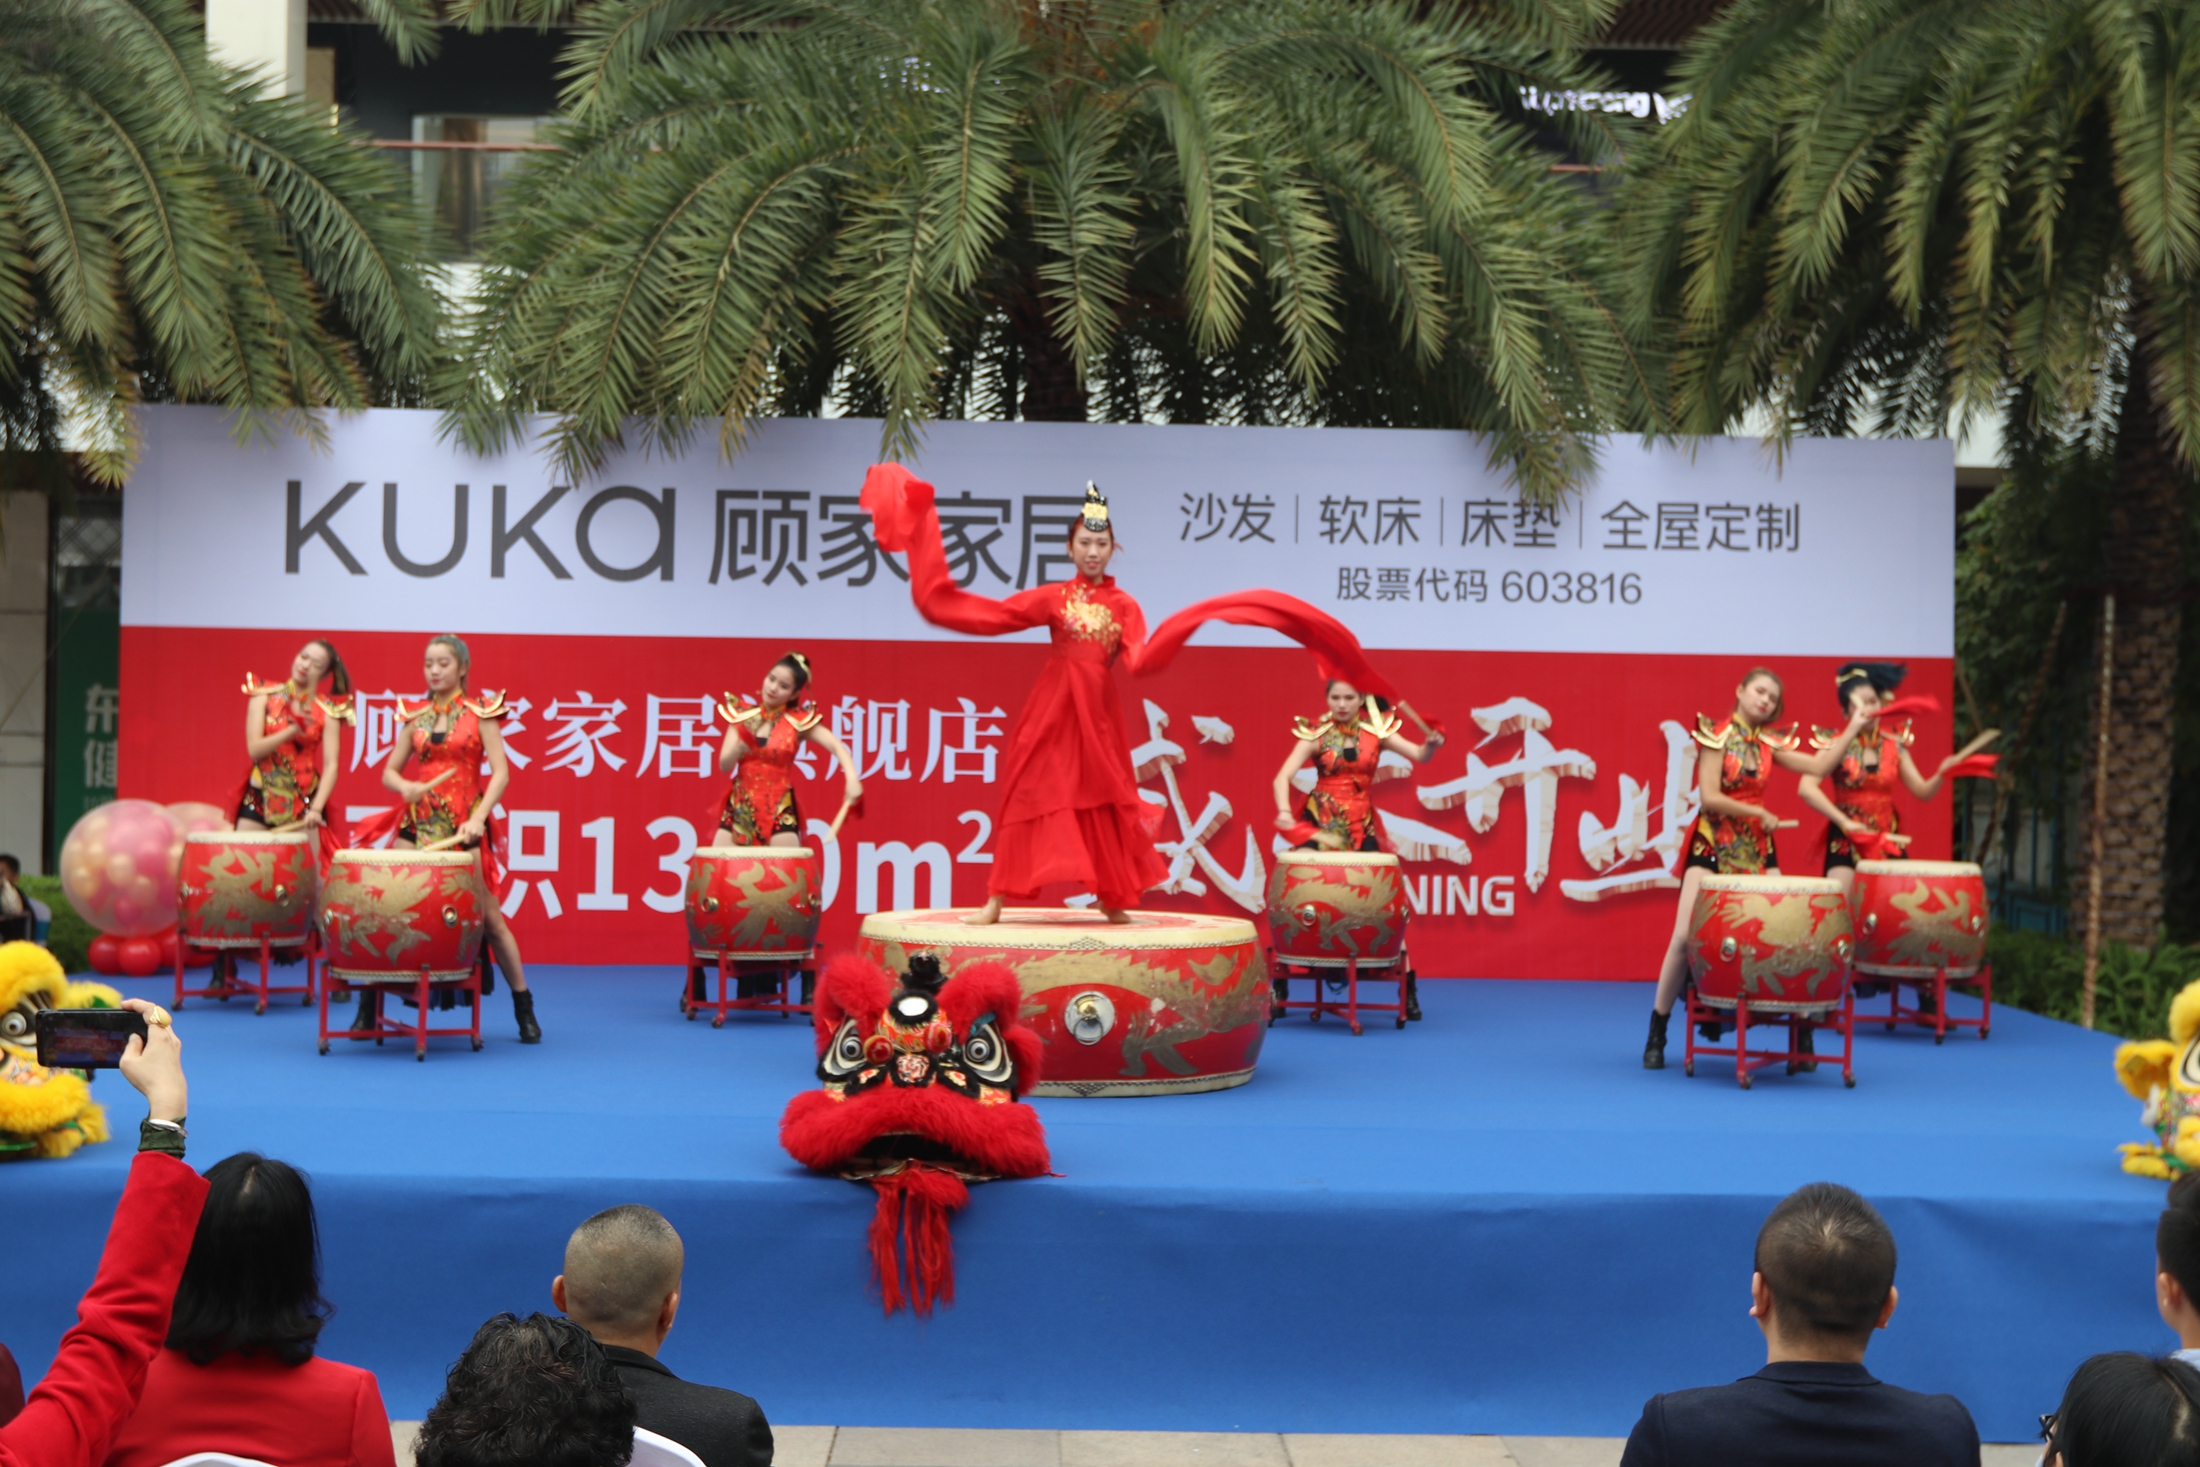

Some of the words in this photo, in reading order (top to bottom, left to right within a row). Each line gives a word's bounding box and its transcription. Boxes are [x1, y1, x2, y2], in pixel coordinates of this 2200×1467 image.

[1180, 492, 1276, 543] 沙发
[1319, 494, 1421, 546] 软床
[1461, 497, 1560, 548] 床垫
[1601, 500, 1799, 552] 全屋定制
[1336, 566, 1488, 603] 股票代码
[1501, 570, 1642, 605] 603816
